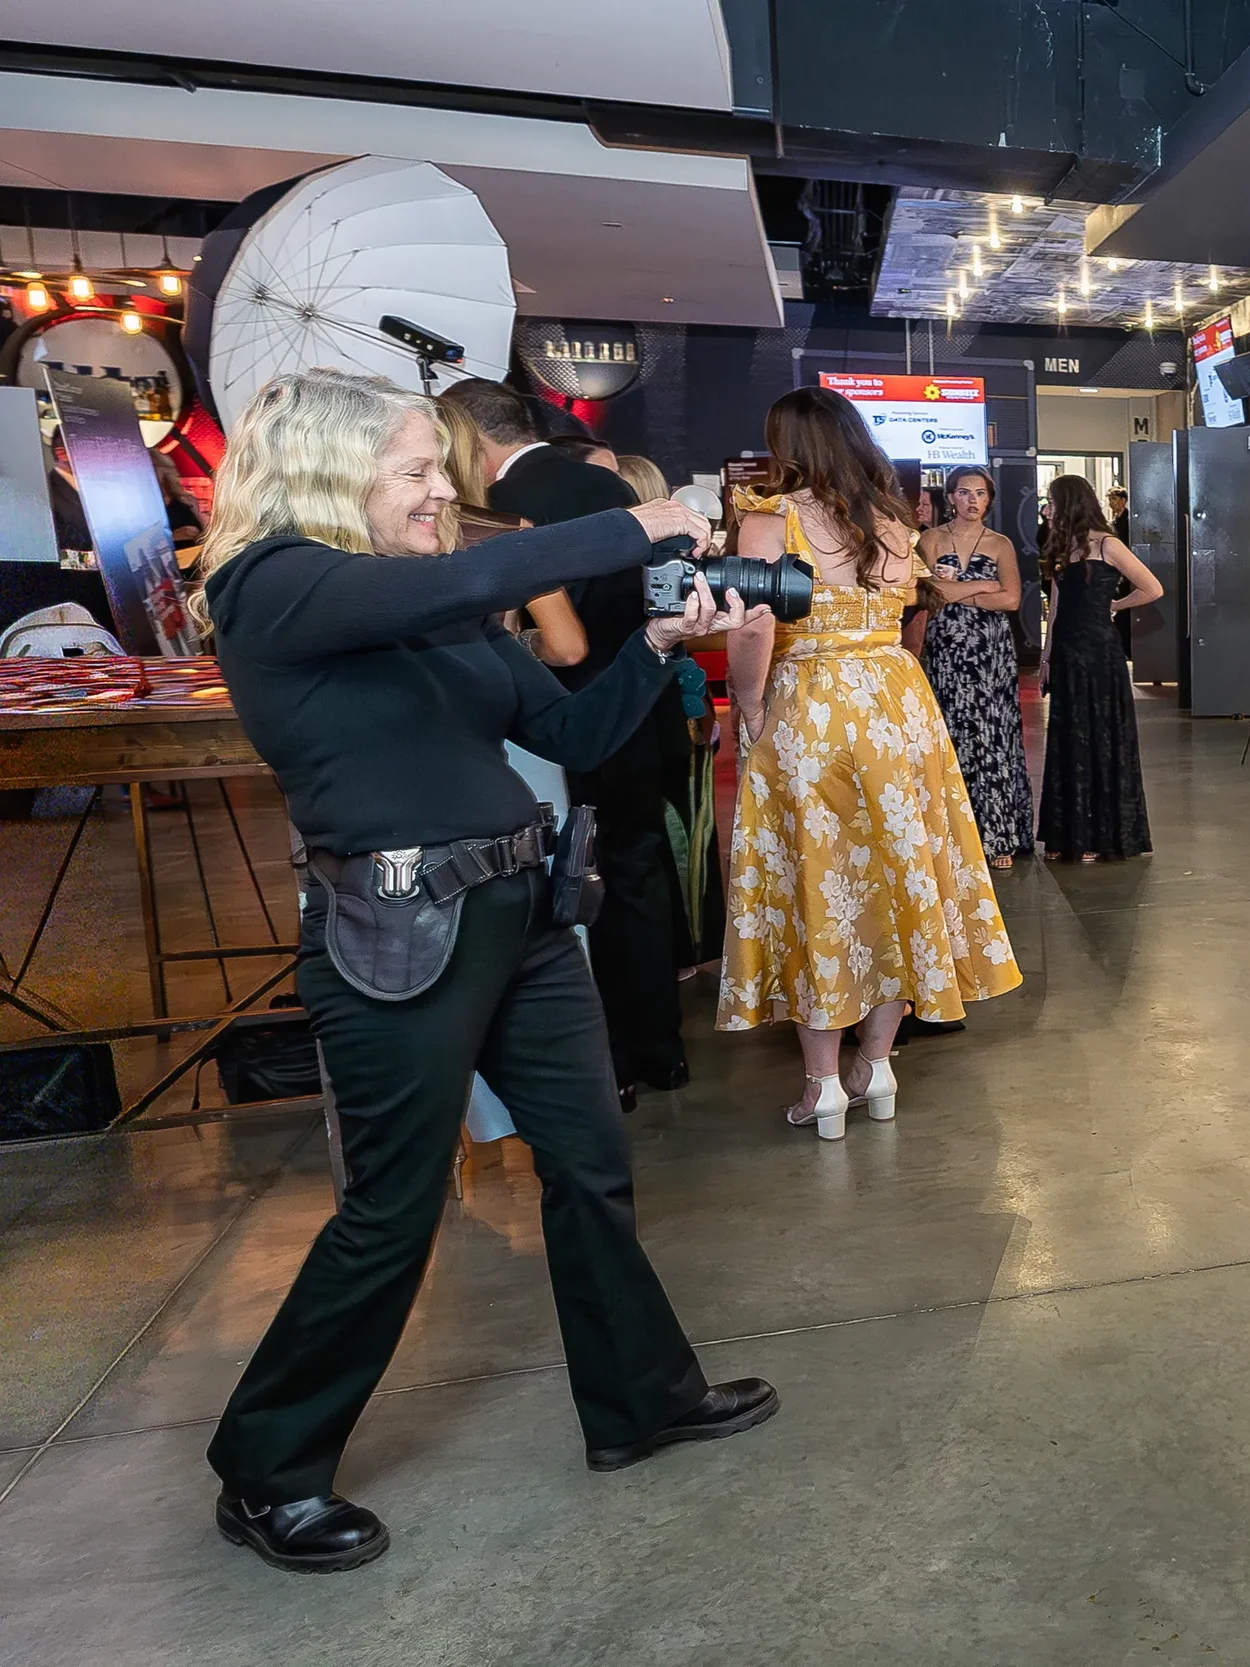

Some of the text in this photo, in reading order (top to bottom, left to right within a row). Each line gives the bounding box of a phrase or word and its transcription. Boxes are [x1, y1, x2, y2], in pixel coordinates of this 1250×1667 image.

[1044, 357, 1080, 374] MEN
[855, 378, 872, 388] you
[873, 378, 884, 387] to
[941, 449, 976, 460] Wealth
